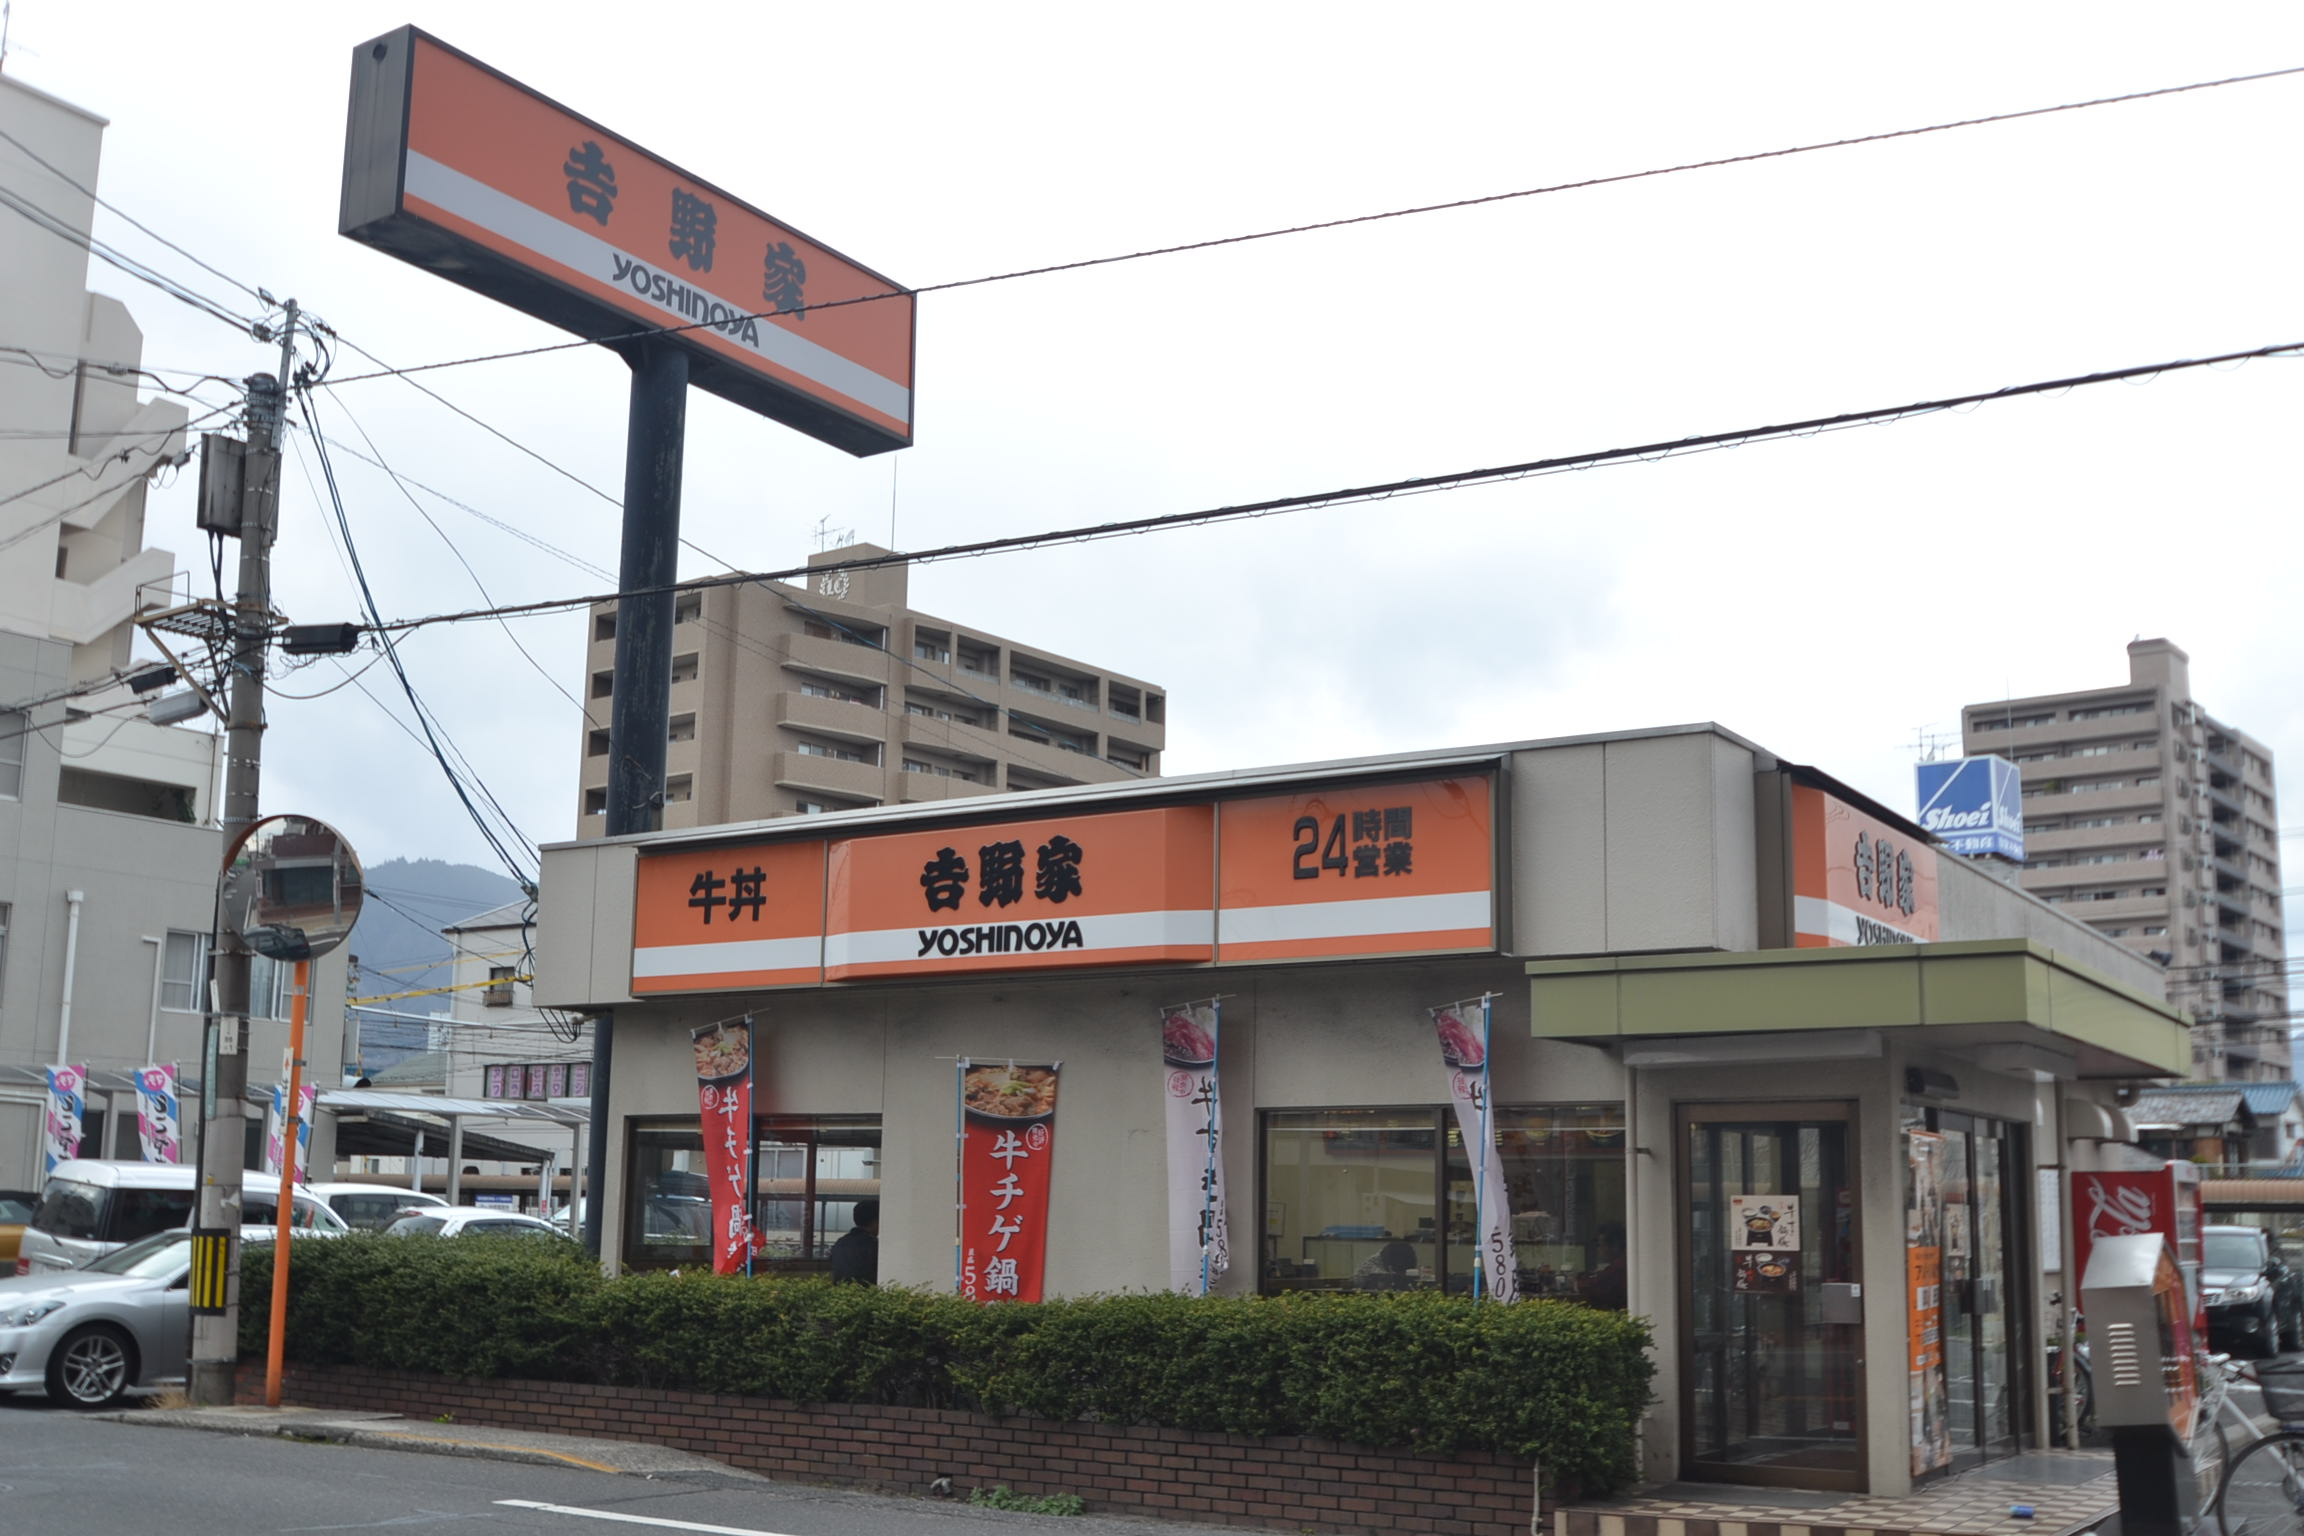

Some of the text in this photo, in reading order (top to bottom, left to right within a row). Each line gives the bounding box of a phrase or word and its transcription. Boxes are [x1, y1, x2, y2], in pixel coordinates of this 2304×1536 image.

[563, 140, 806, 322] 吉野家
[612, 252, 759, 348] YOSHINOYA
[1293, 813, 1349, 880] 24
[1921, 800, 1992, 832] Shoei
[687, 866, 767, 925] 牛丼
[920, 834, 1083, 913] 吉野家
[1854, 829, 1916, 918] 吉野家
[917, 920, 1084, 958] YOSHINOYA
[983, 1130, 1029, 1297] 牛チゲ鍋
[1491, 1231, 1507, 1299] 580
